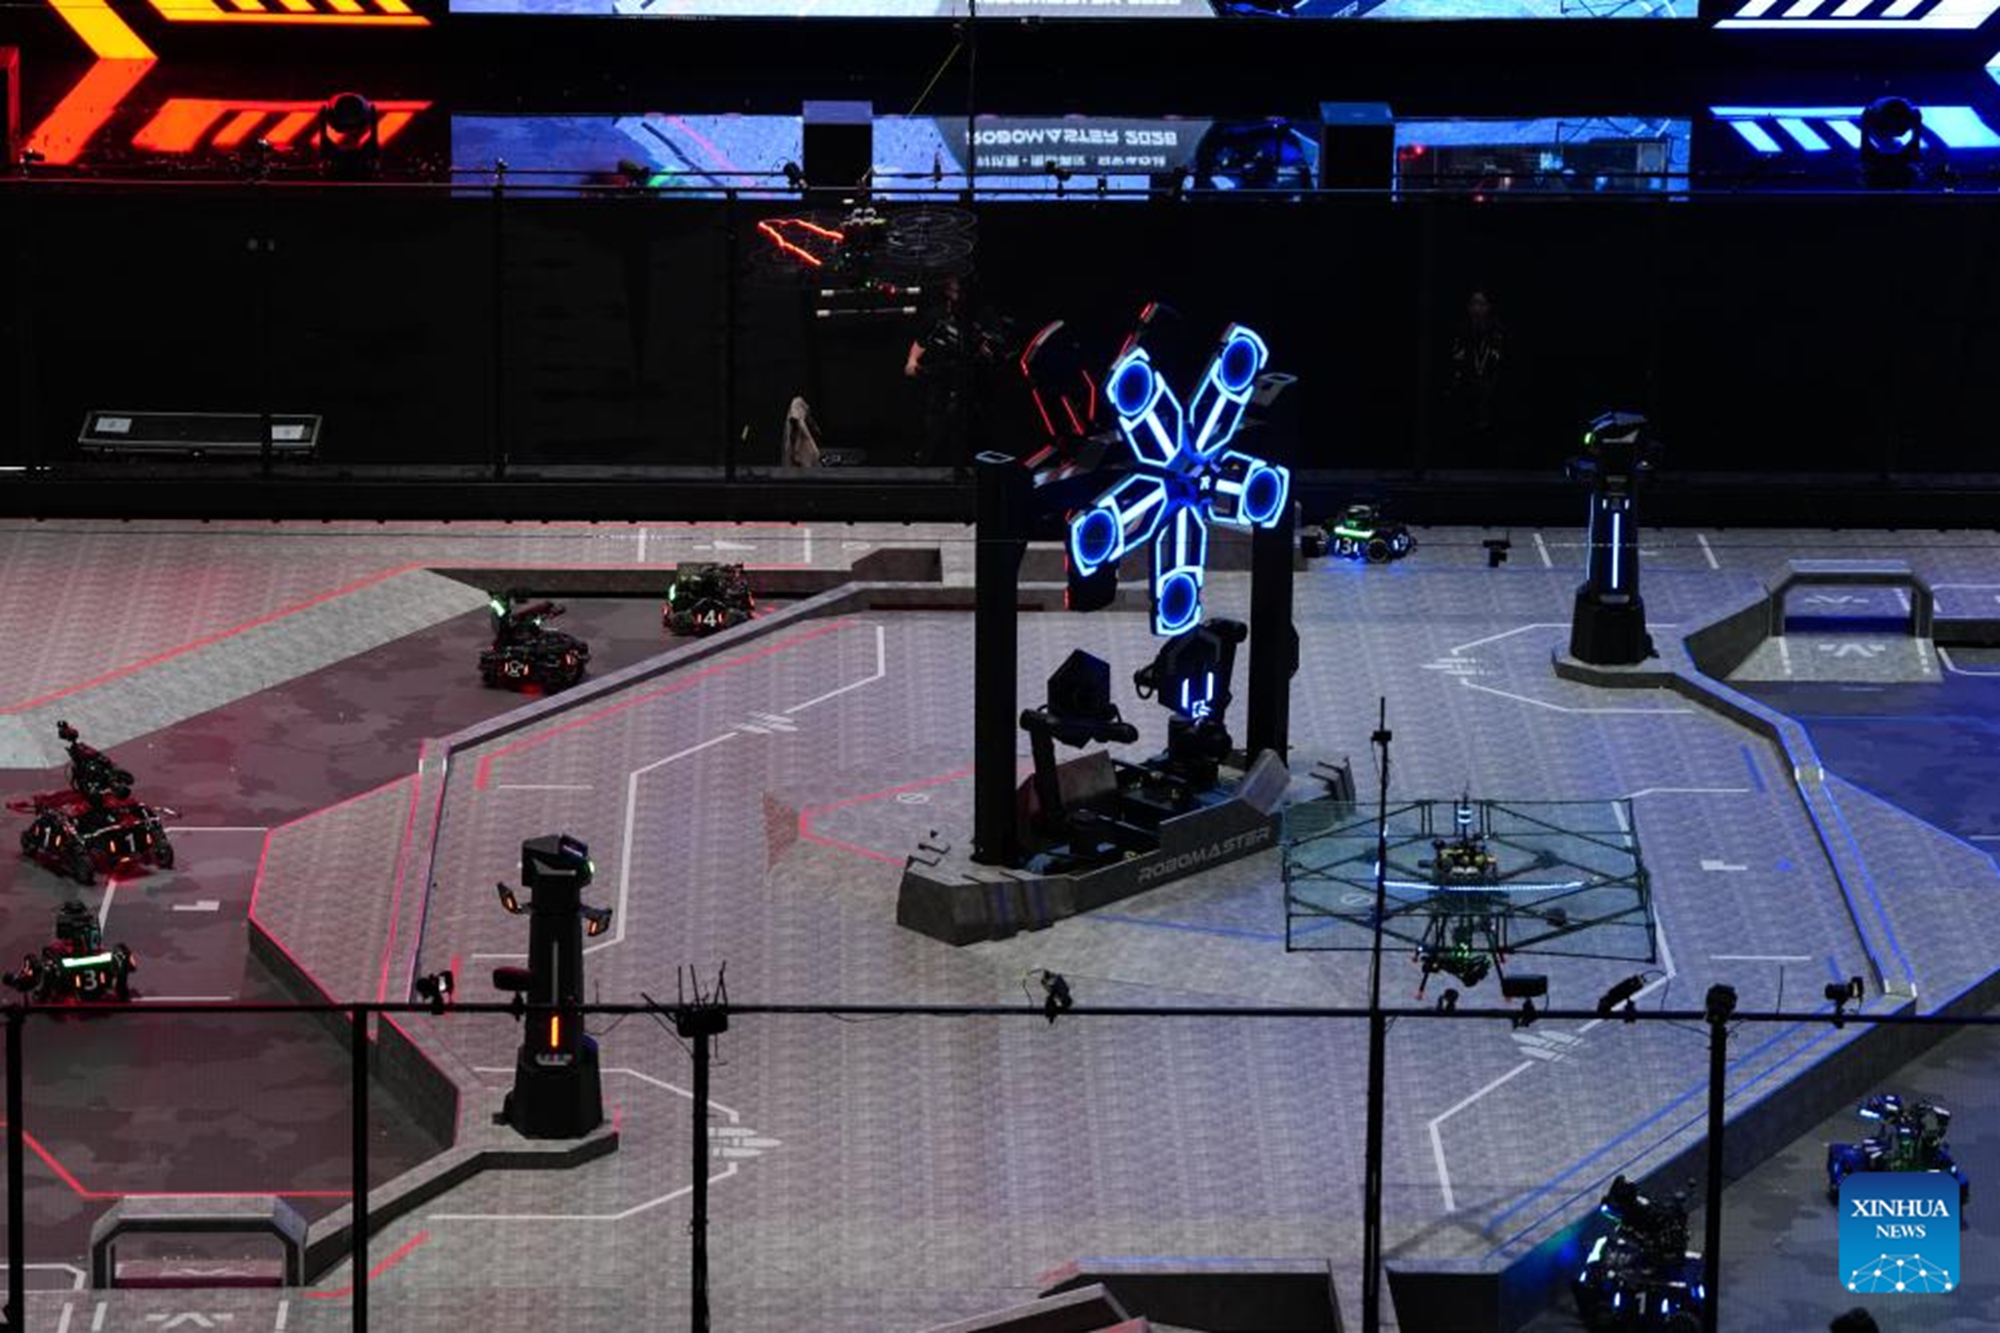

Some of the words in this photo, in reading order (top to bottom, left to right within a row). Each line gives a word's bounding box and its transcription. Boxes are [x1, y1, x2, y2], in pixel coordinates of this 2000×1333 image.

[703, 609, 717, 627] 4
[125, 833, 136, 853] 1
[1137, 826, 1272, 884] ROBOMASTER
[84, 969, 98, 990] 3
[1635, 1291, 1647, 1315] 1
